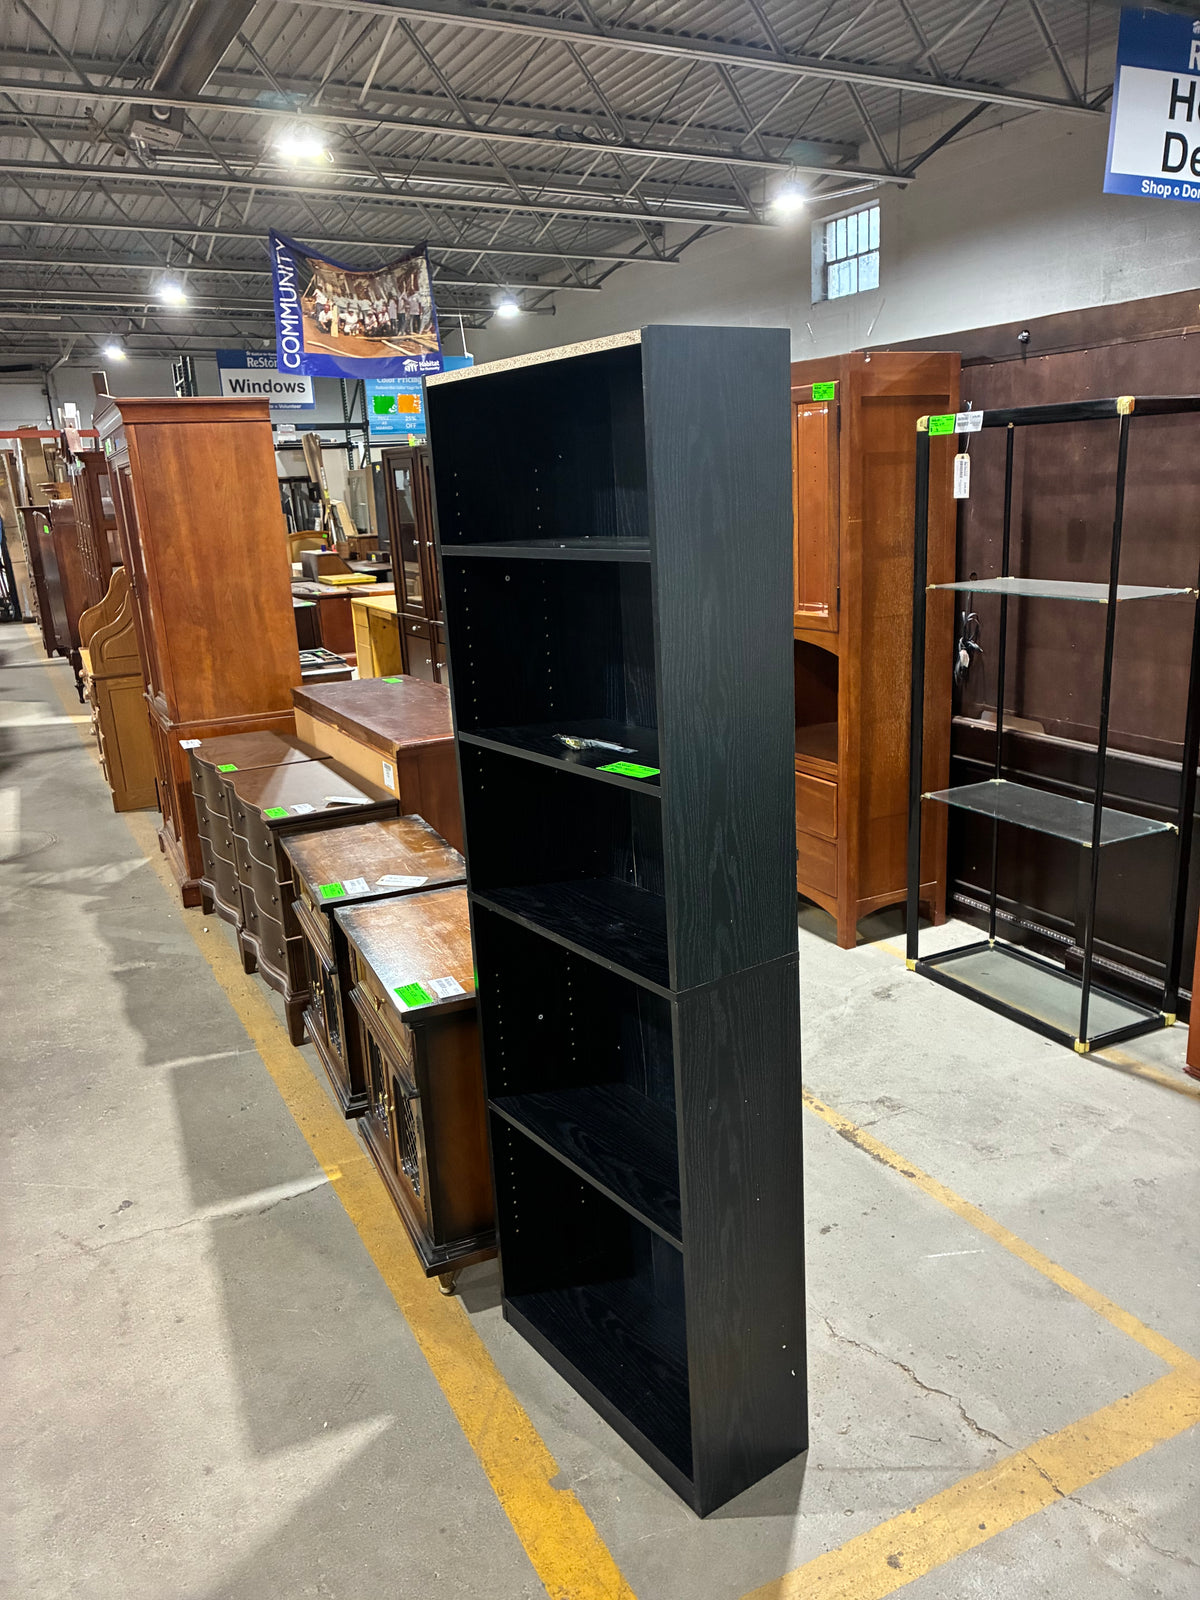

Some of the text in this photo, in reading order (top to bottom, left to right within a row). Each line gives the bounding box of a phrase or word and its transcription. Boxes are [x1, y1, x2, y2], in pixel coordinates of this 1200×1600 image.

[1168, 78, 1200, 122] H
[1141, 179, 1172, 199] Shop
[275, 238, 301, 369] COMMUNITY
[228, 378, 306, 393] Windows
